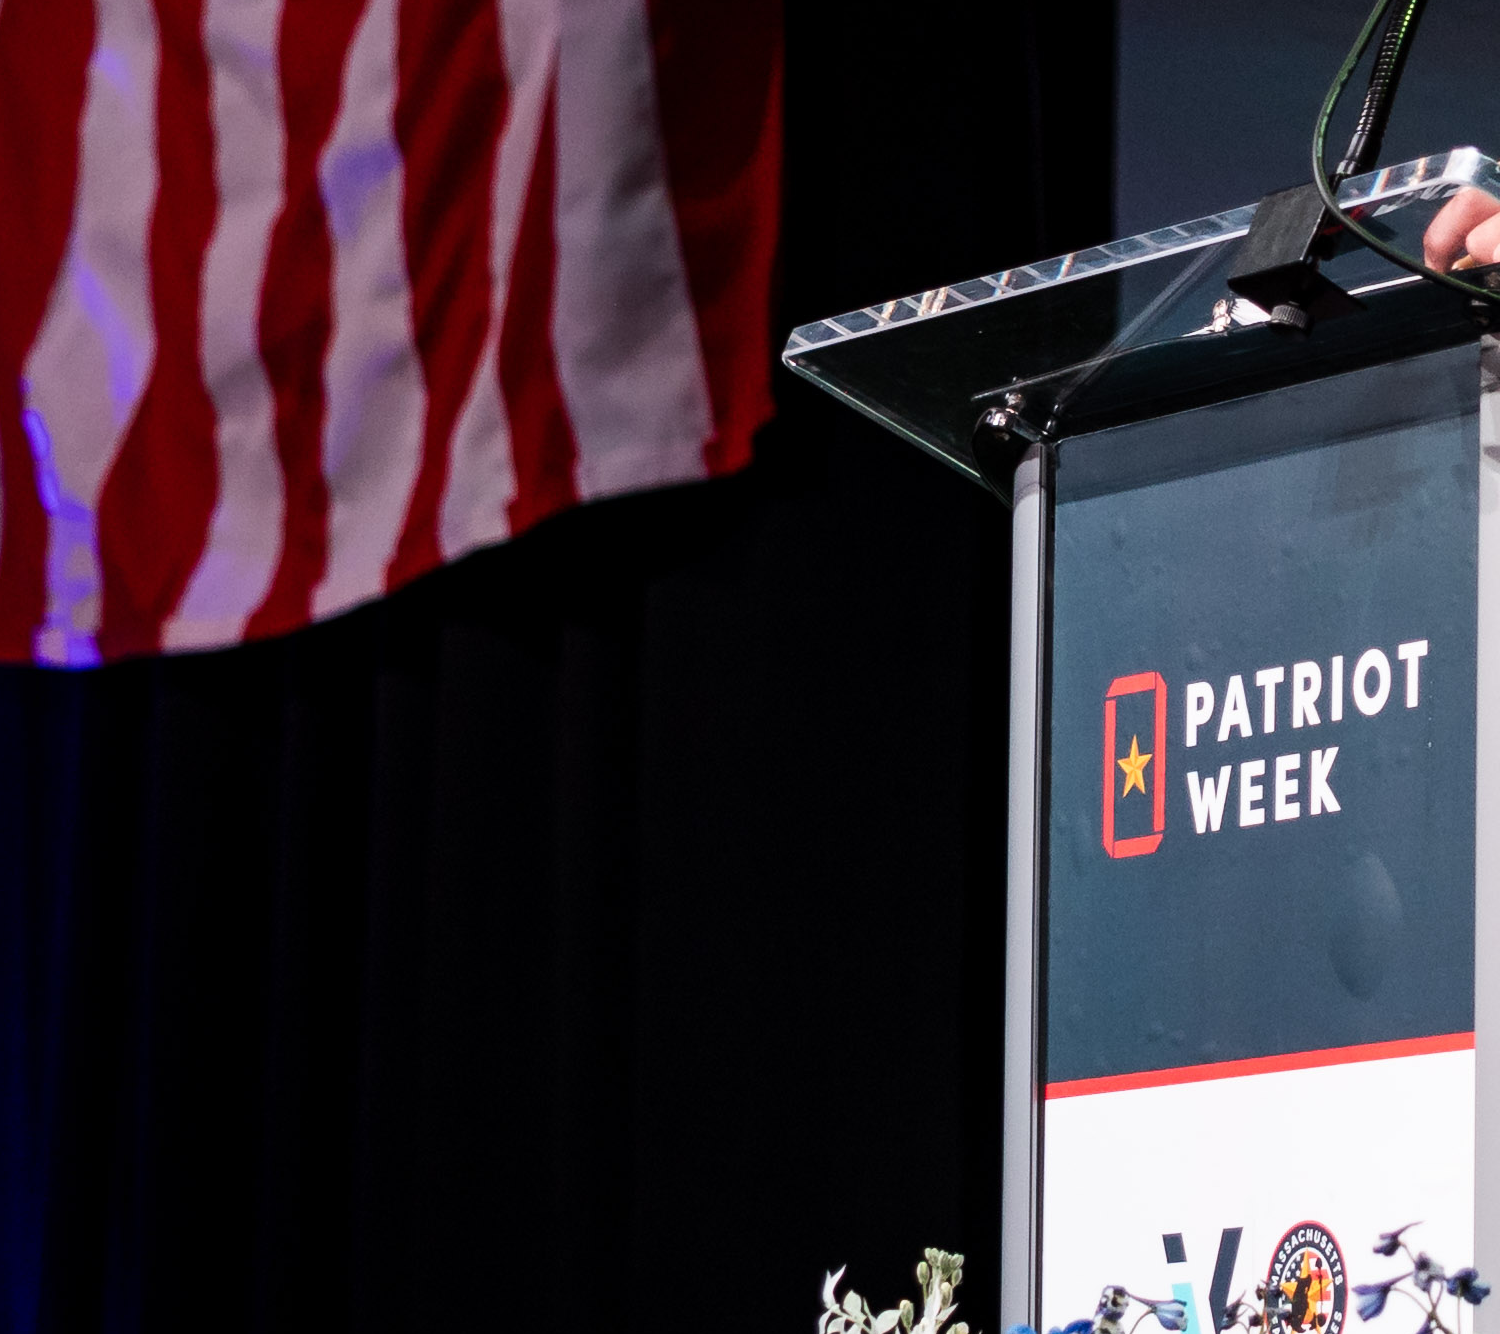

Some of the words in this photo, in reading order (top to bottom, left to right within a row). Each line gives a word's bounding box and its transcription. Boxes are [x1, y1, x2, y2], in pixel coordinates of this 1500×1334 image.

[1185, 639, 1428, 747] PATRIOT
[1186, 747, 1341, 834] WEEK
[1269, 1228, 1343, 1287] MASSACHUSETTS
